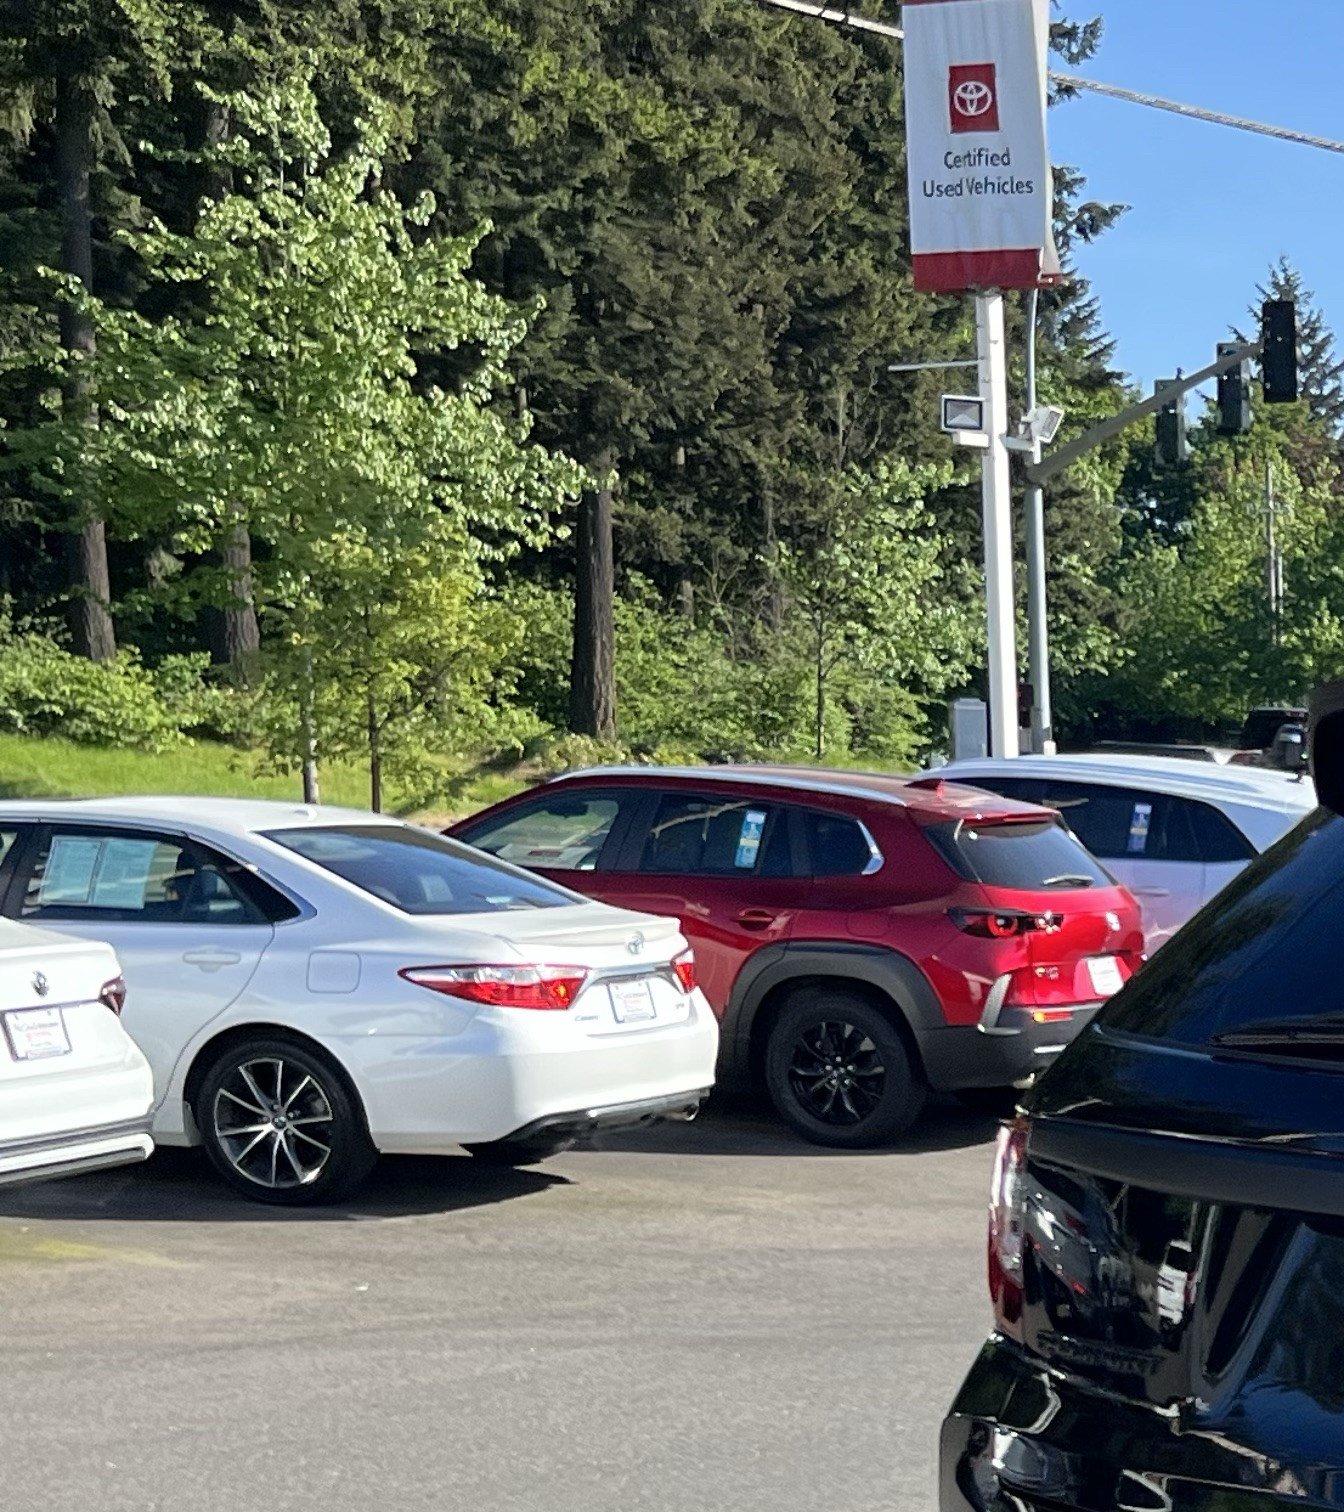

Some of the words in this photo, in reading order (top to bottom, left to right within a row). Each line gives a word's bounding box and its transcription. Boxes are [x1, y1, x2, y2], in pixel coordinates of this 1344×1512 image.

[943, 147, 1011, 170] Certified
[923, 178, 963, 198] Used
[965, 175, 1034, 196] Vehicles
